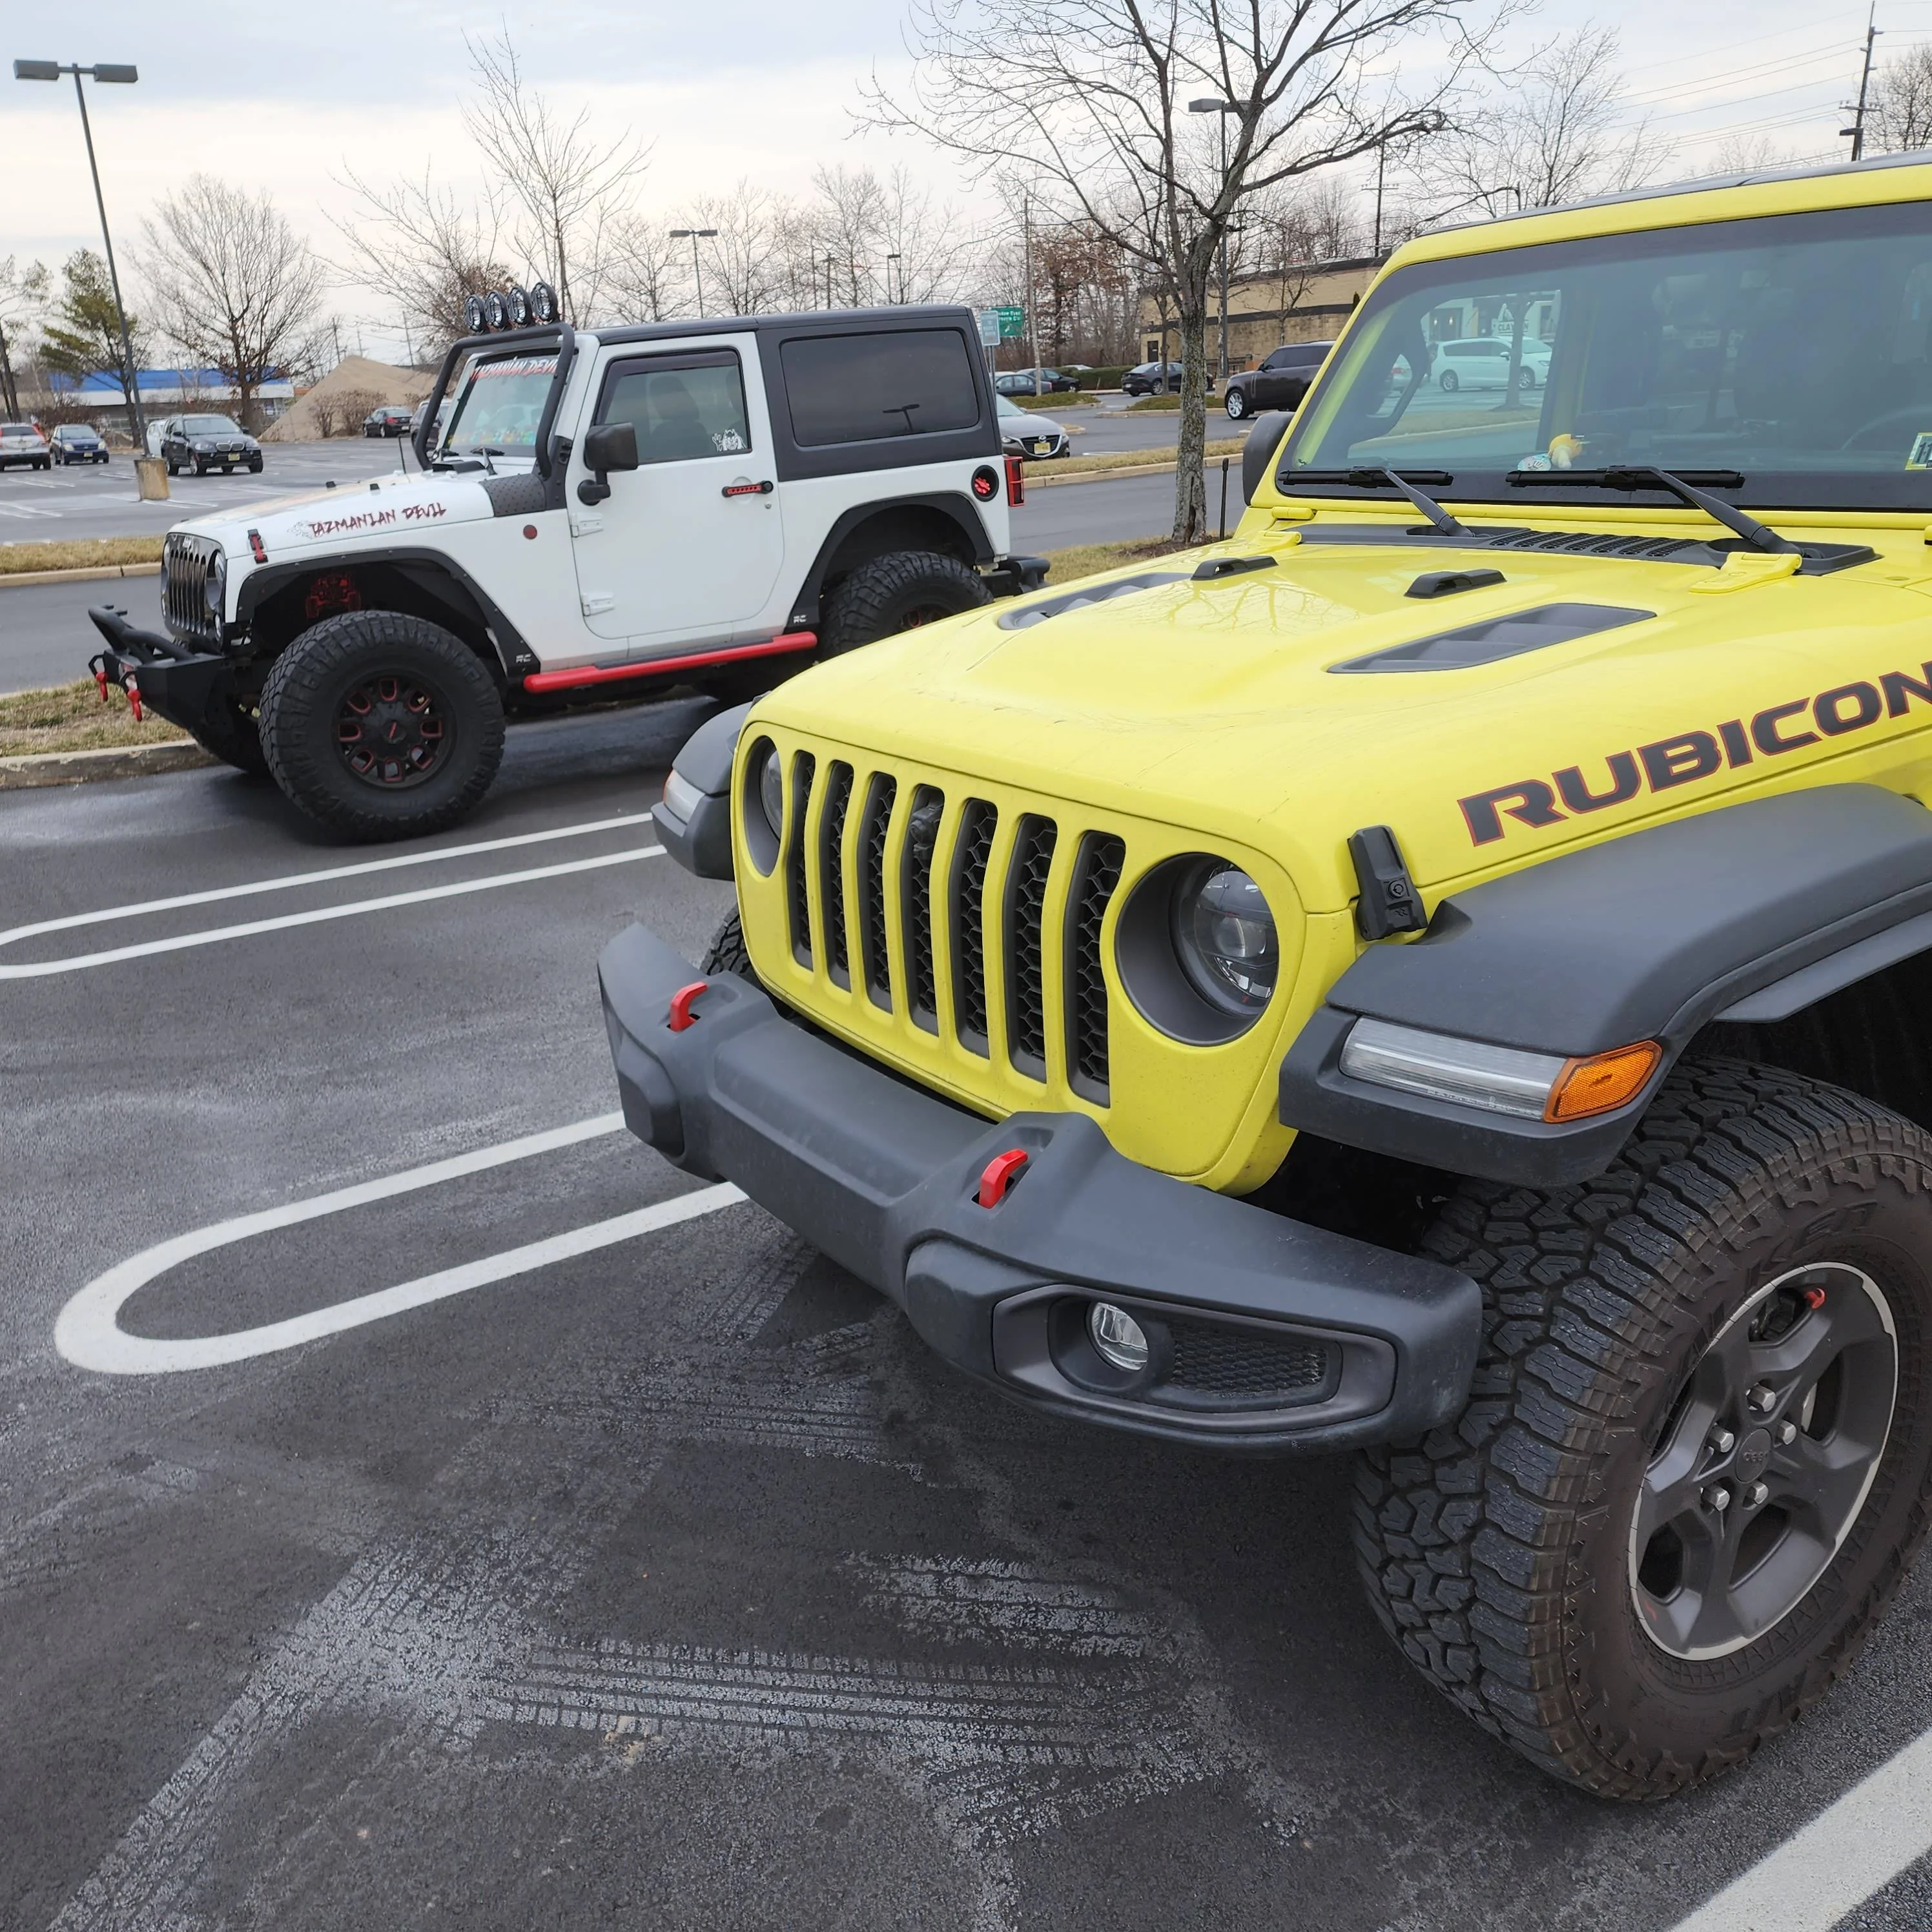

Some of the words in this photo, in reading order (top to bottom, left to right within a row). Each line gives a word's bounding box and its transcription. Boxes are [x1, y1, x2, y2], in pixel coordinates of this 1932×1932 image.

[308, 509, 396, 537] TAZMANIAN
[402, 503, 447, 519] DEVIL
[1457, 661, 1932, 847] RUBICON
